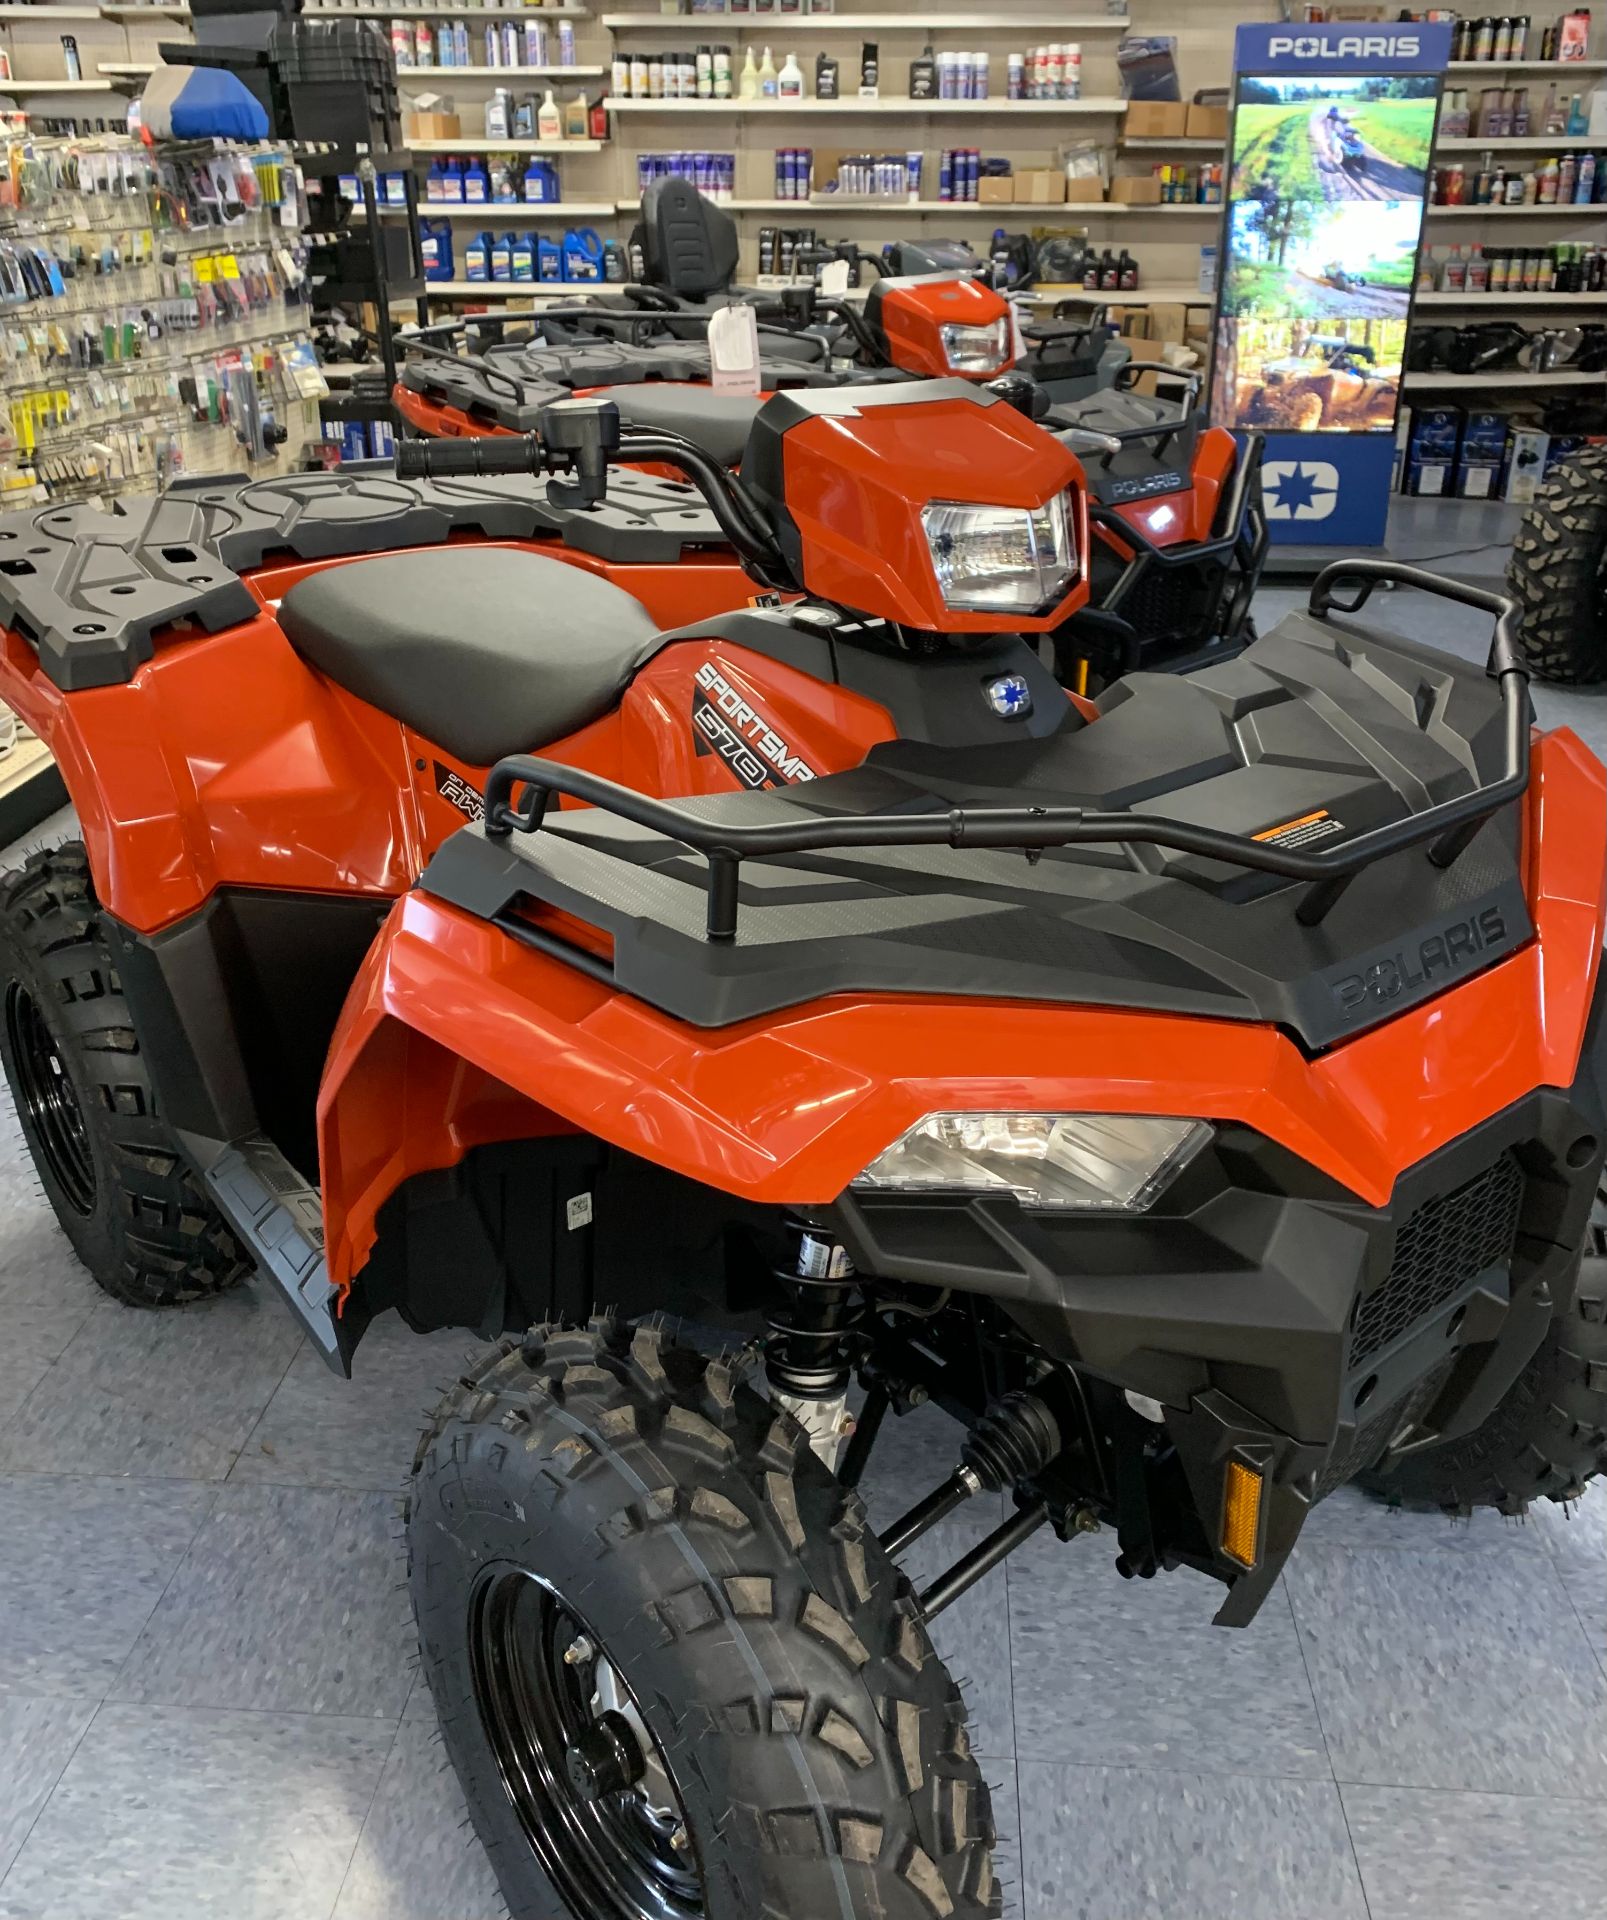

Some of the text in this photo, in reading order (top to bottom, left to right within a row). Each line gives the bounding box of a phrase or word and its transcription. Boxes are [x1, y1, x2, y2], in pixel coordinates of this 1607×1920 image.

[1268, 37, 1420, 58] POLARIS
[1112, 472, 1181, 498] POLARIS
[694, 662, 817, 782] SPORTSMA
[694, 703, 767, 787] 570
[1330, 905, 1507, 1022] POLARIS
